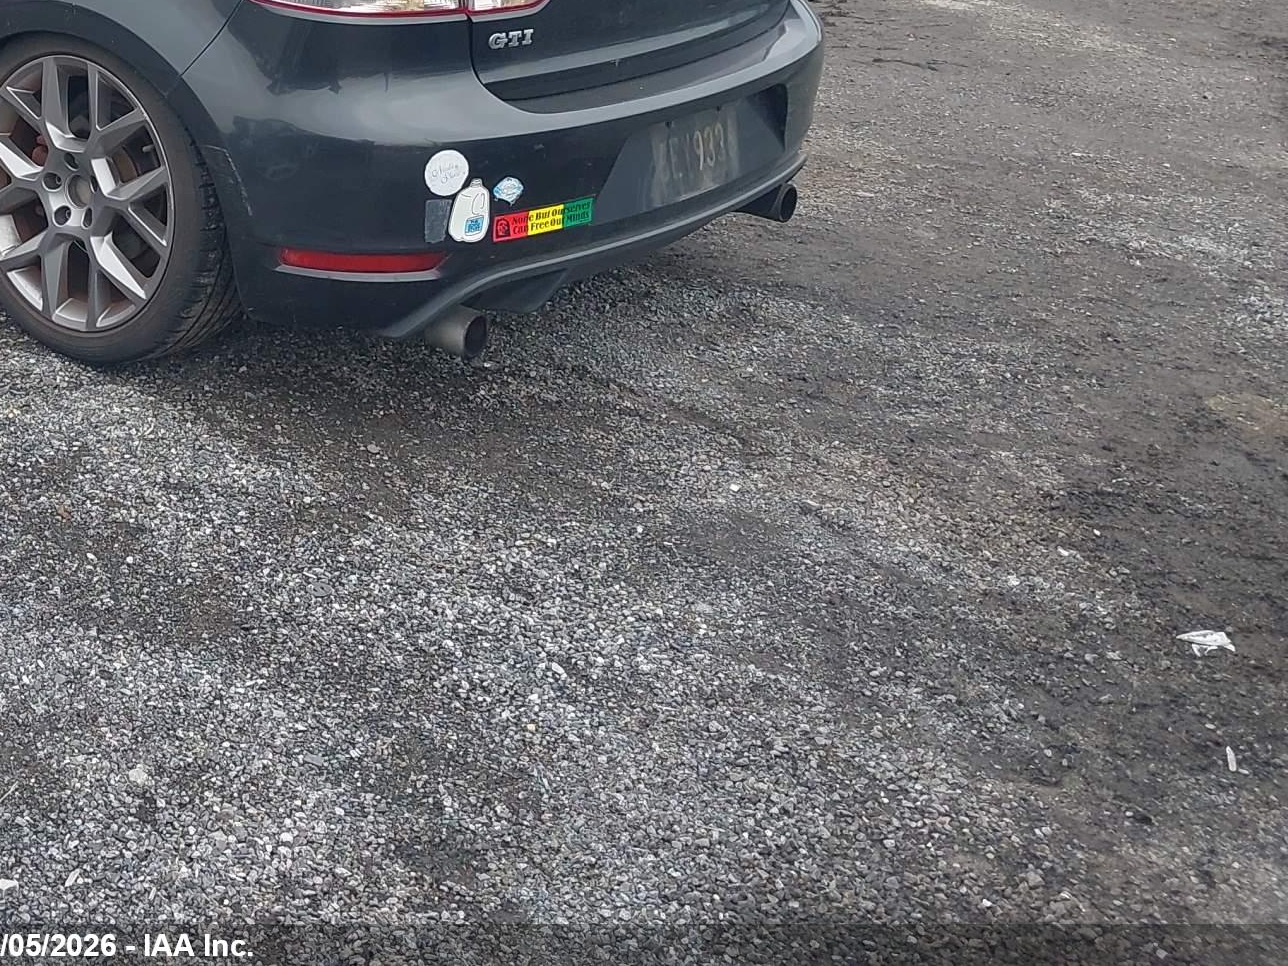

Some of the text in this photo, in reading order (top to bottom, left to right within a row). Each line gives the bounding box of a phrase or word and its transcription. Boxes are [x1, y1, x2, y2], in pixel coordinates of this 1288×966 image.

[488, 28, 534, 50] GTI
[535, 210, 550, 220] But
[530, 221, 549, 232] Free
